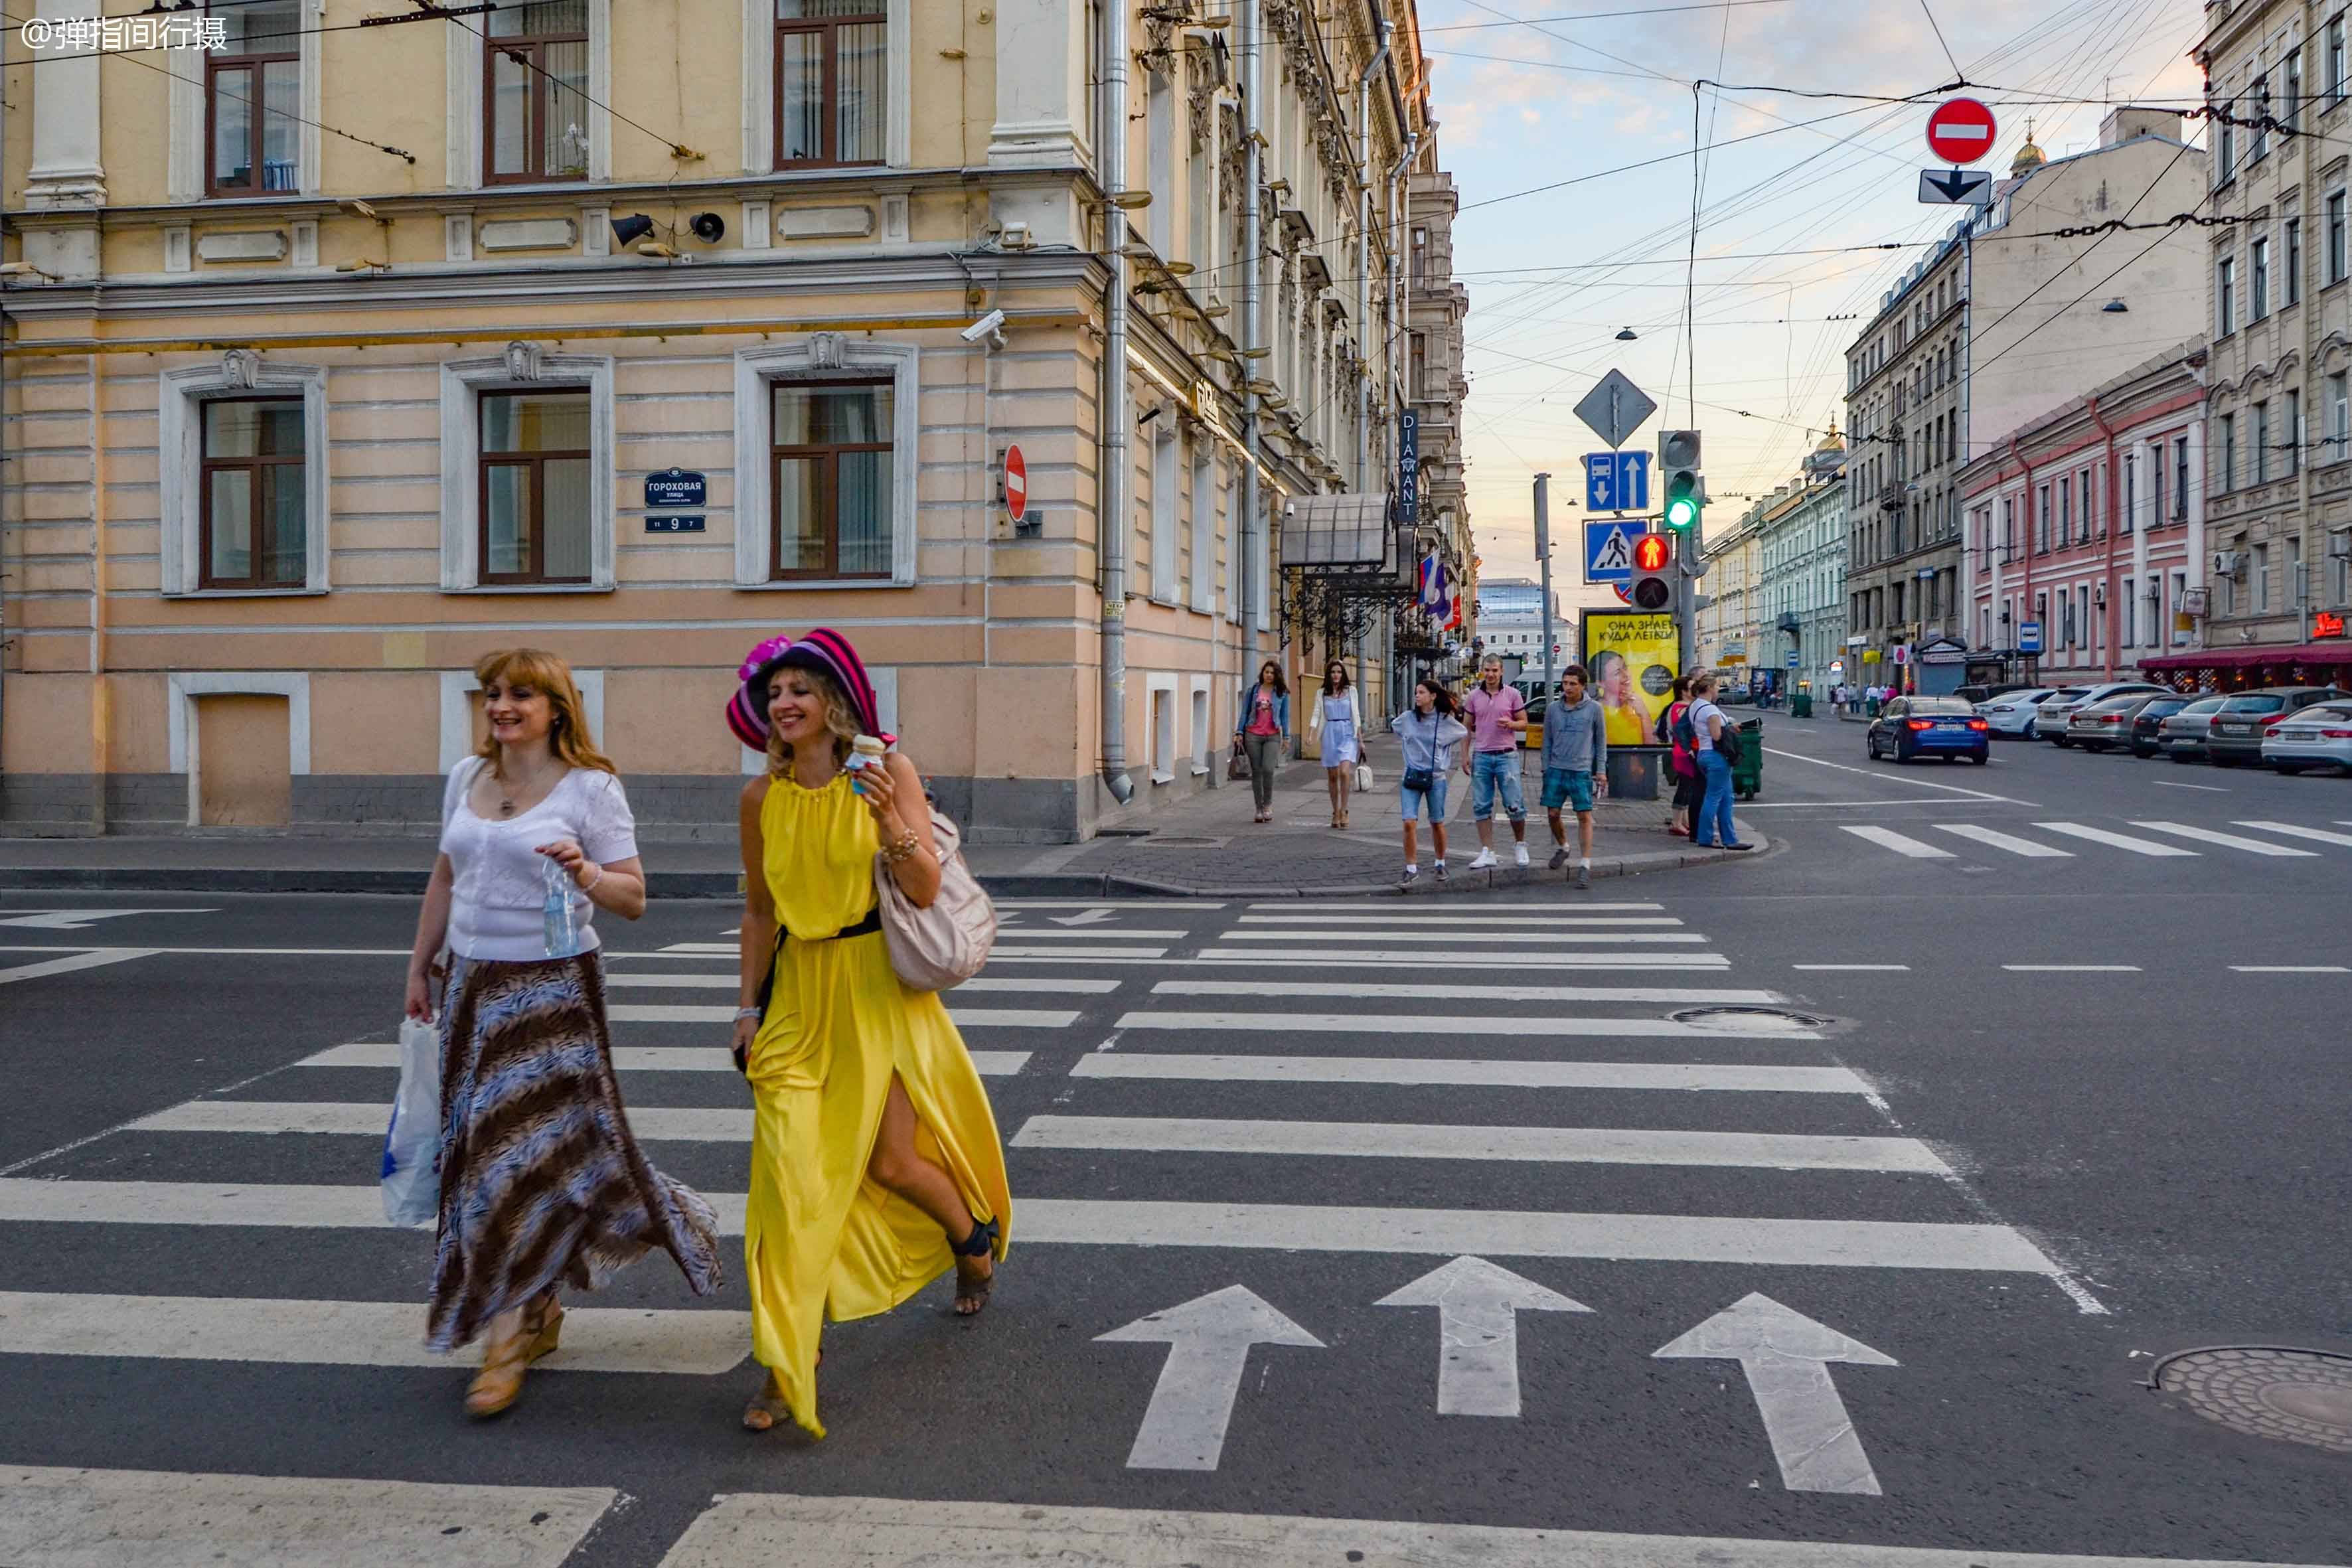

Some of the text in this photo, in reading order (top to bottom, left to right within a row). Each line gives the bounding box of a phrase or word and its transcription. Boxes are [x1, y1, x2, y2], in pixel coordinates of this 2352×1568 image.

[1402, 416, 1415, 515] DIAMANT
[649, 483, 701, 491] ГОРОХОВАЯ
[671, 518, 679, 530] 9
[1608, 621, 1635, 631] ОНА
[1599, 631, 1630, 641] КУДА
